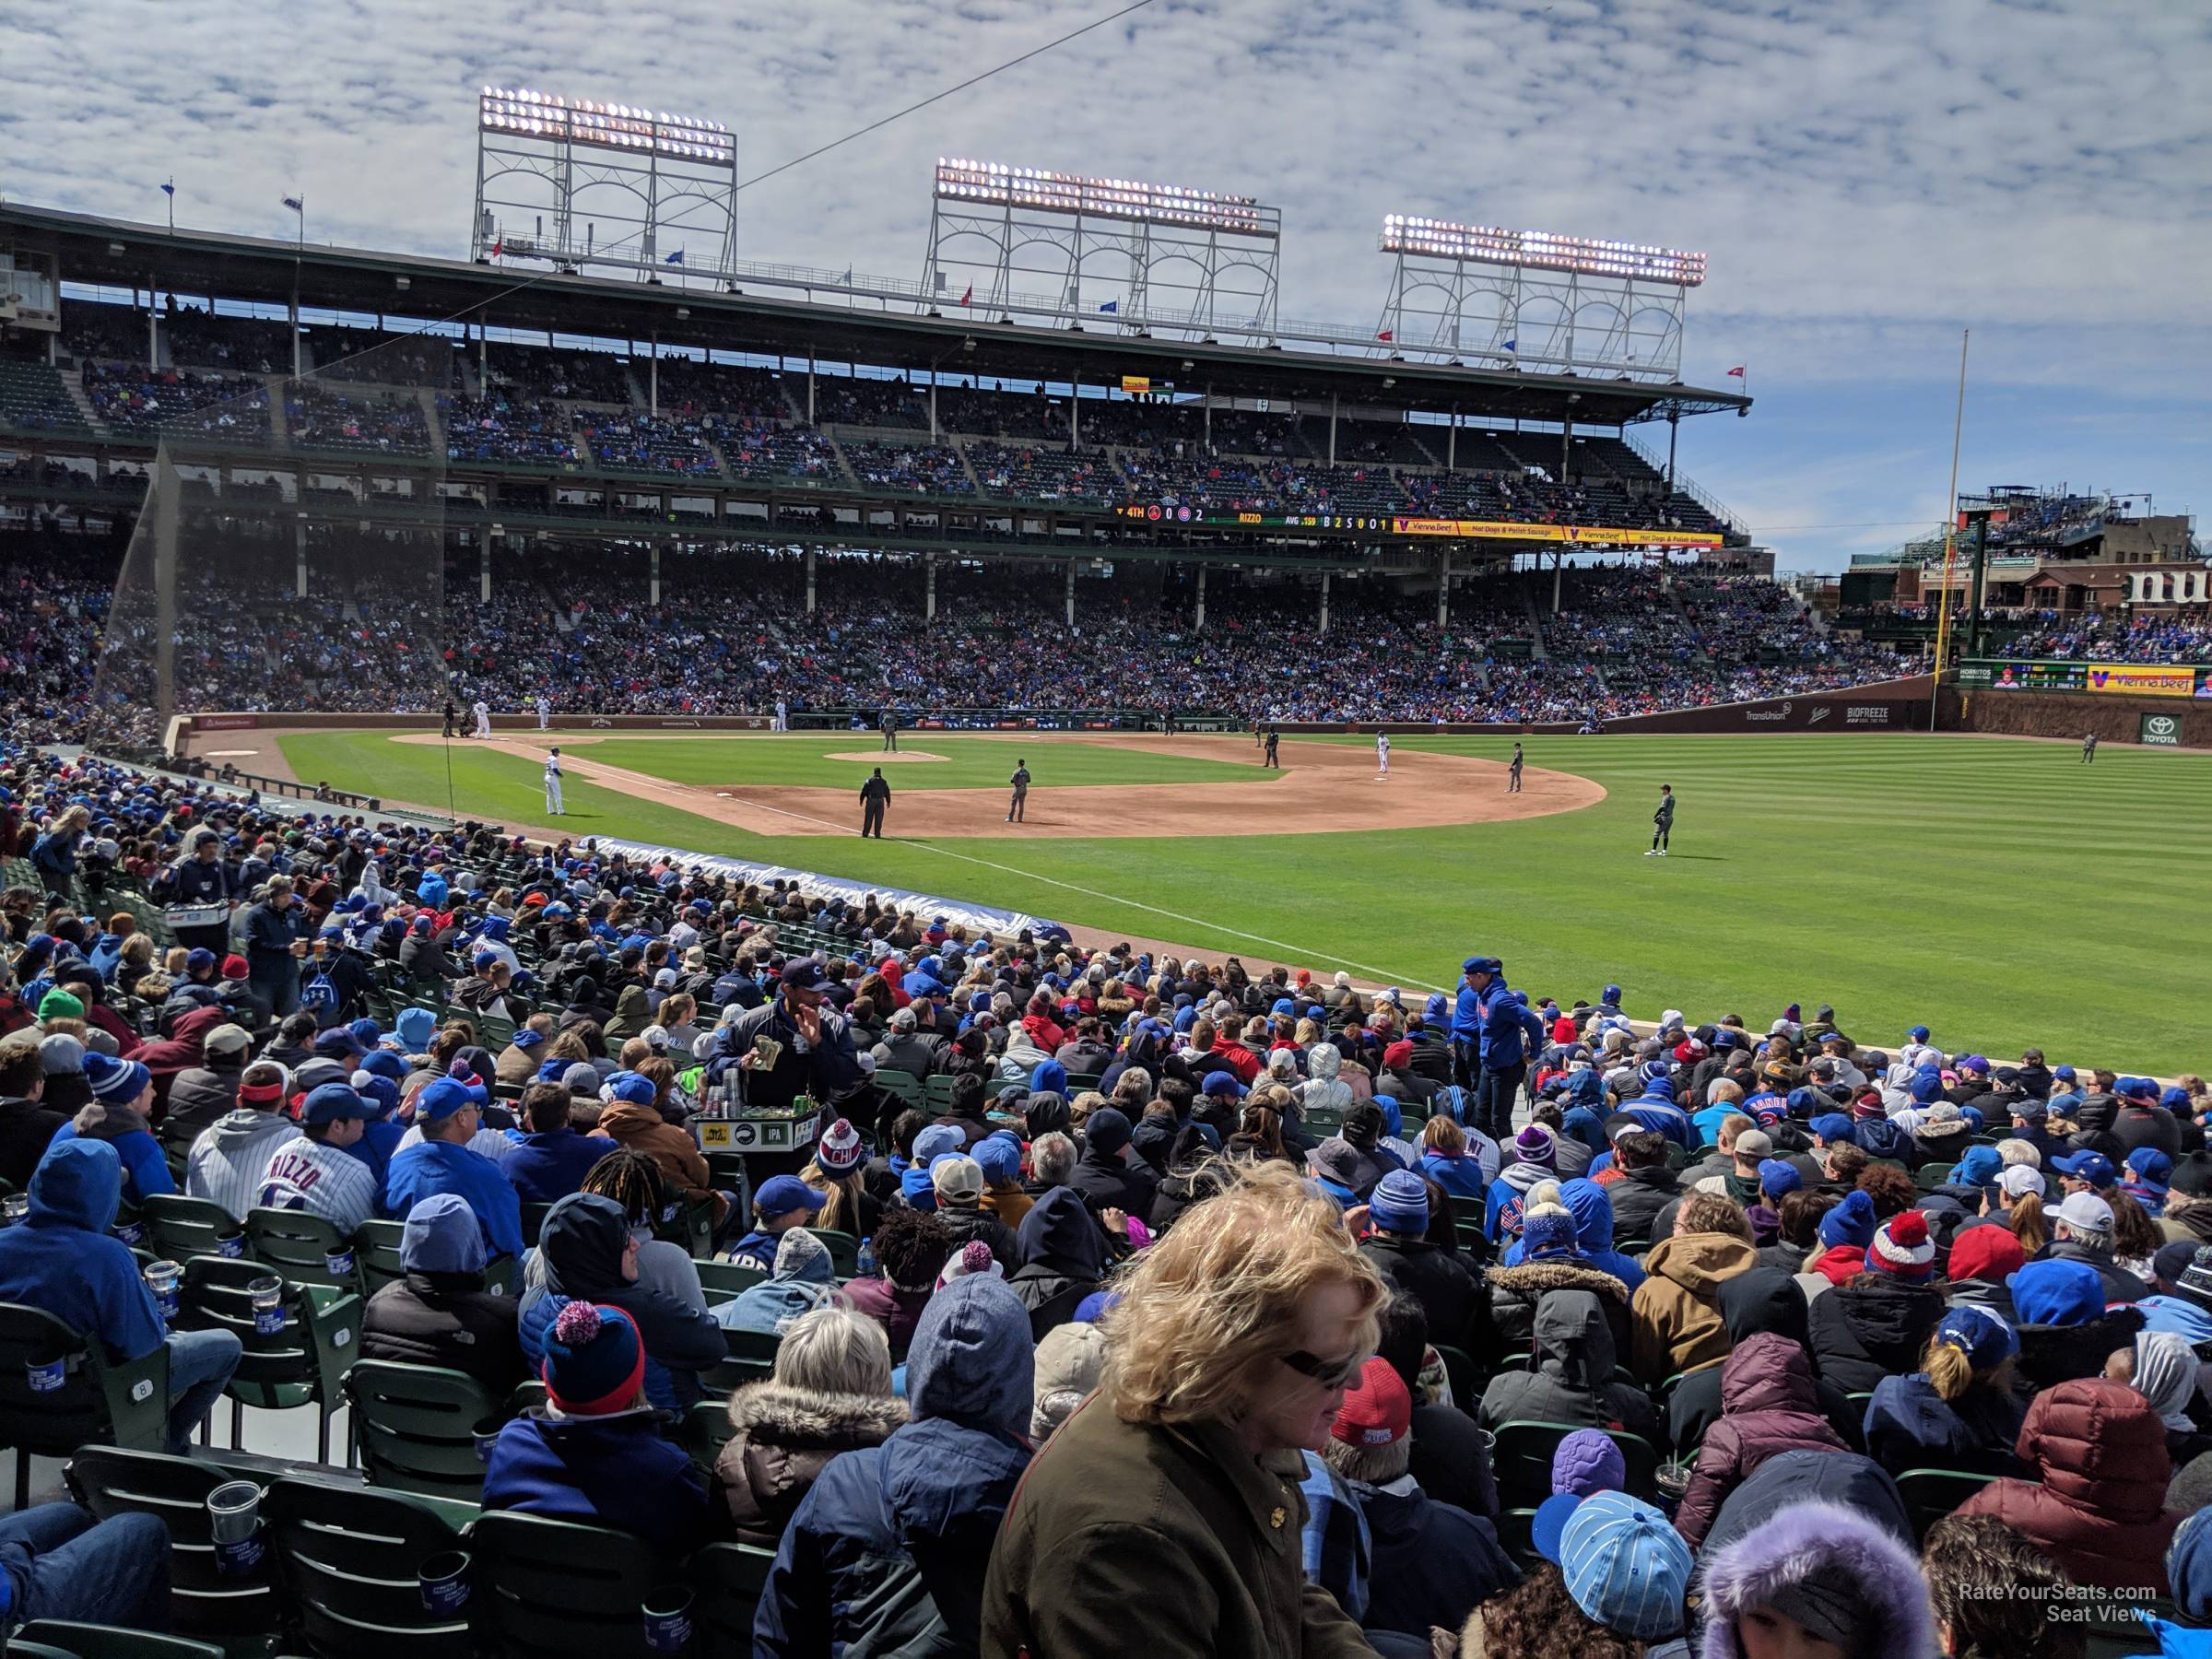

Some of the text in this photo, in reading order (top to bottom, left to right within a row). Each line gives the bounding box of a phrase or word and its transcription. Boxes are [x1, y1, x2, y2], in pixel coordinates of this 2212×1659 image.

[1127, 507, 1203, 521] 4TH 0 2
[1239, 512, 1261, 524] RIZZO
[1286, 516, 1299, 525] AVG
[1324, 517, 1330, 527] B
[1335, 518, 1341, 528] 2
[1347, 518, 1353, 529] S
[1358, 518, 1364, 529] 0
[1381, 520, 1385, 530] 1
[1485, 526, 1500, 535] Dogs
[1746, 711, 1786, 721] TransUnion
[1847, 707, 1888, 718] BIOFREEZE
[2144, 734, 2178, 745] TOYOTA
[768, 1128, 782, 1141] IPA
[831, 1149, 853, 1164] CHI
[270, 1154, 322, 1191] RIZZO
[140, 1383, 147, 1395] 8
